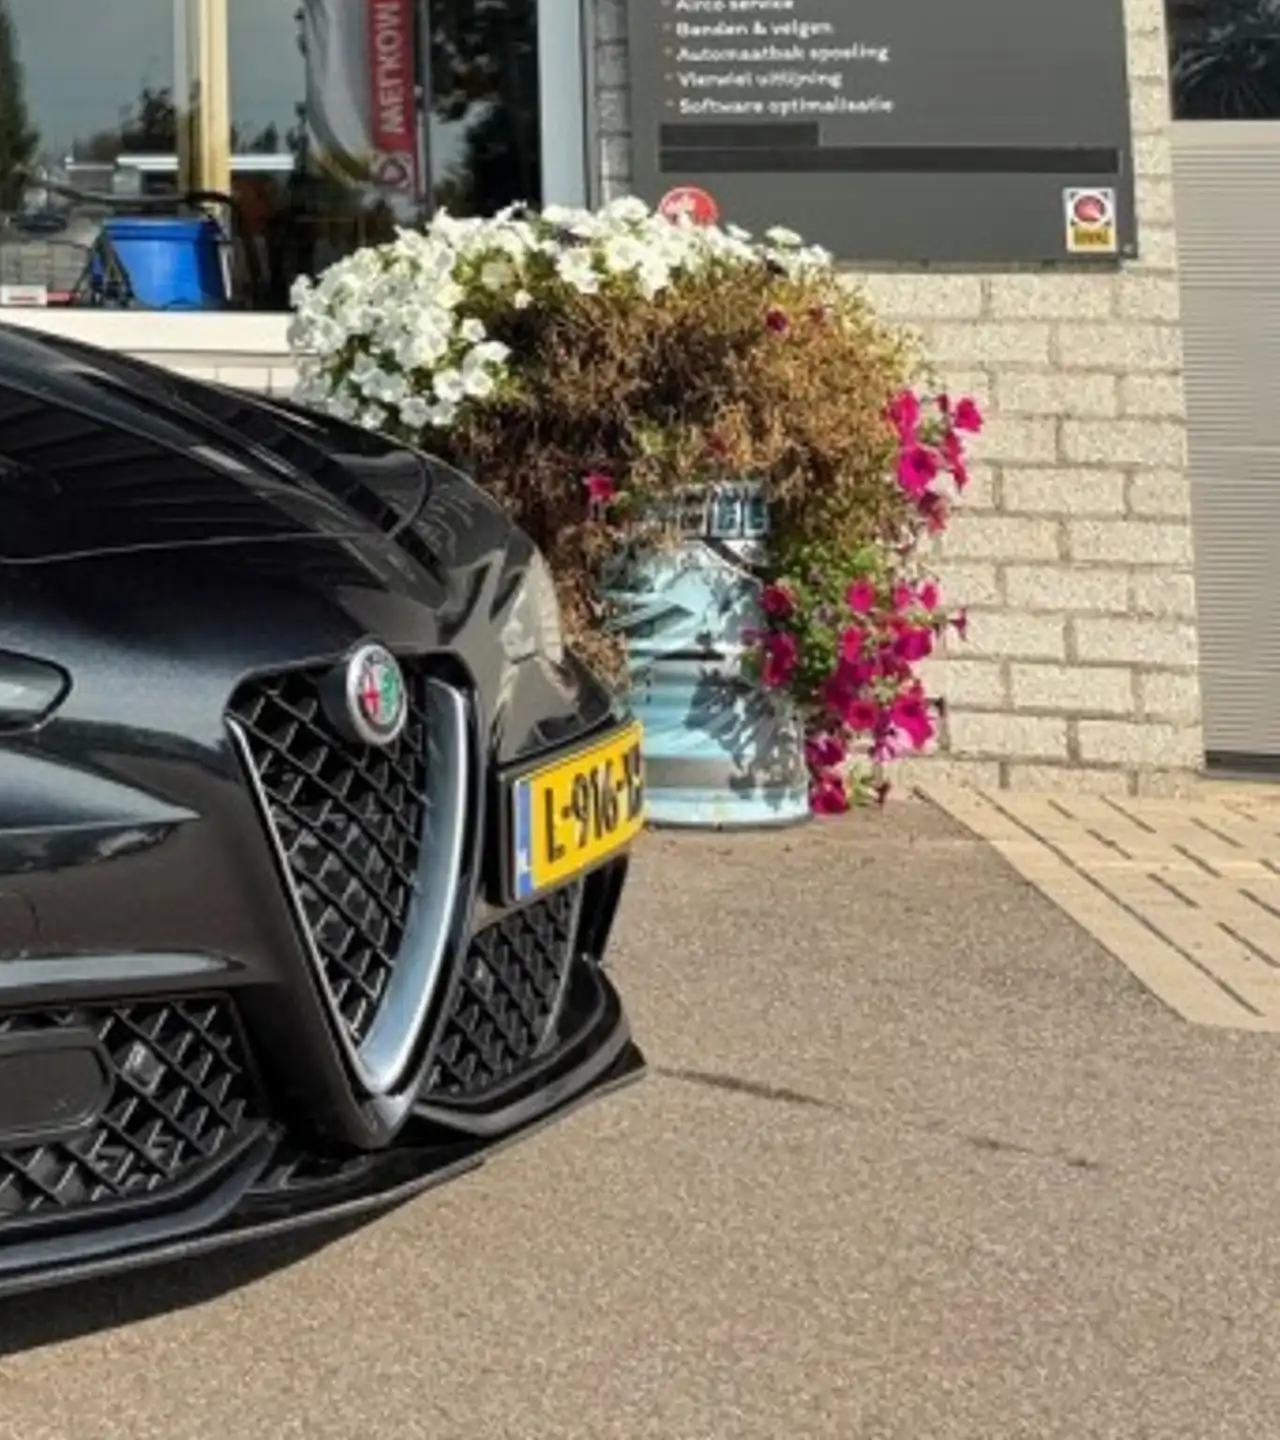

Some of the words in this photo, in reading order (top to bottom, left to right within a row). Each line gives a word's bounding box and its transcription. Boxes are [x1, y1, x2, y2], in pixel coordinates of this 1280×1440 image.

[675, 21, 749, 38] Banden
[770, 18, 834, 40] velgen
[675, 44, 806, 63] Automaatbak
[808, 42, 890, 63] spoeling
[678, 97, 765, 115] Software
[766, 95, 894, 118] optimalisatie
